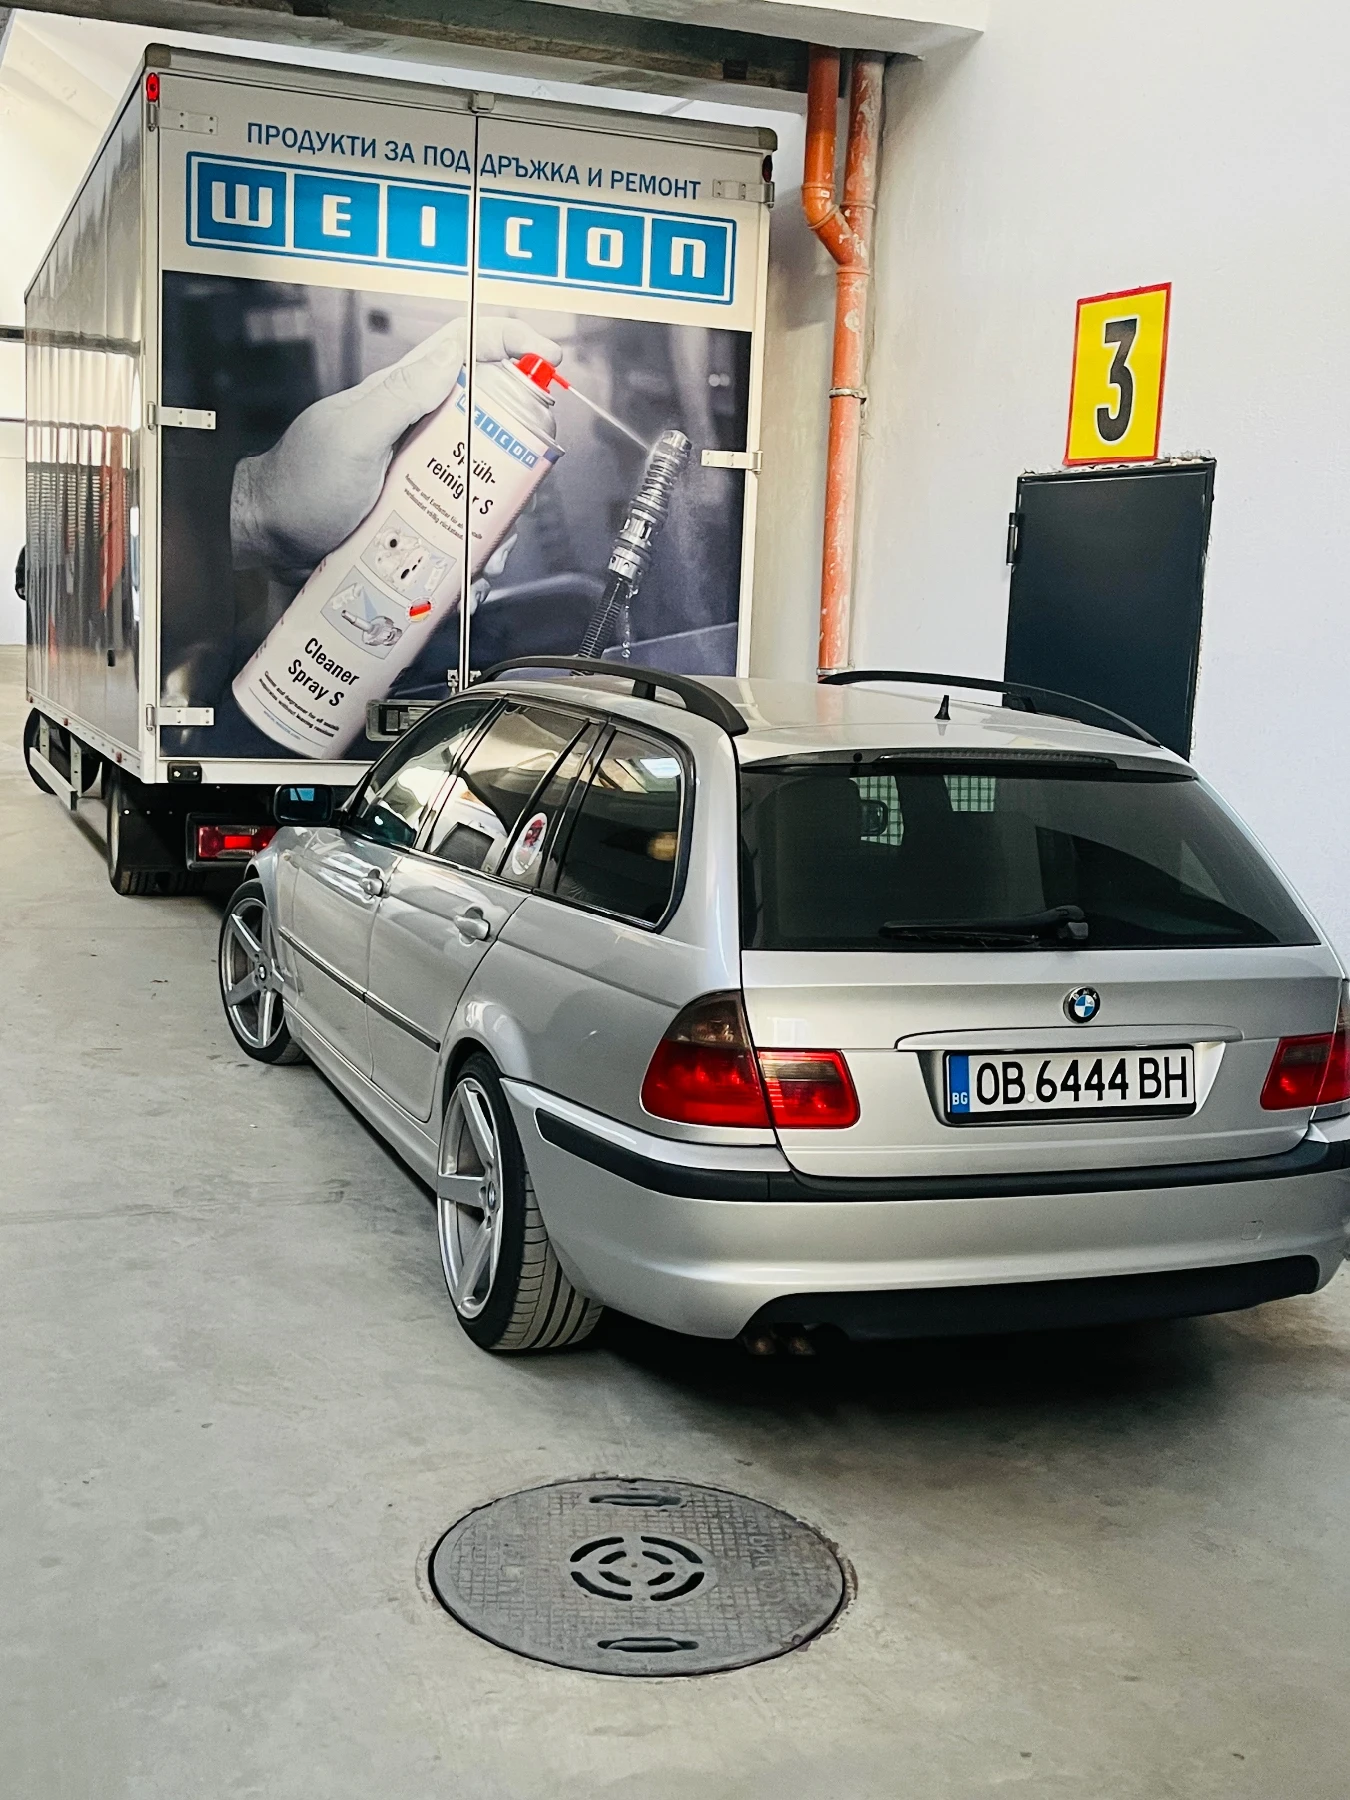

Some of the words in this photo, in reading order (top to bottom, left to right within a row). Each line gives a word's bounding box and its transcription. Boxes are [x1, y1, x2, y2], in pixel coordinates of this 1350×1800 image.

[247, 122, 377, 159] ПРОДУКТИ
[384, 140, 415, 164] ЗА
[588, 167, 603, 188] И
[610, 170, 702, 200] РЕМОНТ
[1096, 317, 1138, 442] 3
[427, 457, 480, 505] reinigr
[453, 442, 496, 484] Süh-
[288, 659, 330, 701] Spray
[328, 691, 345, 707] S
[304, 637, 360, 686] Cleaner
[952, 1091, 968, 1105] BG
[1035, 1058, 1129, 1103] 6444
